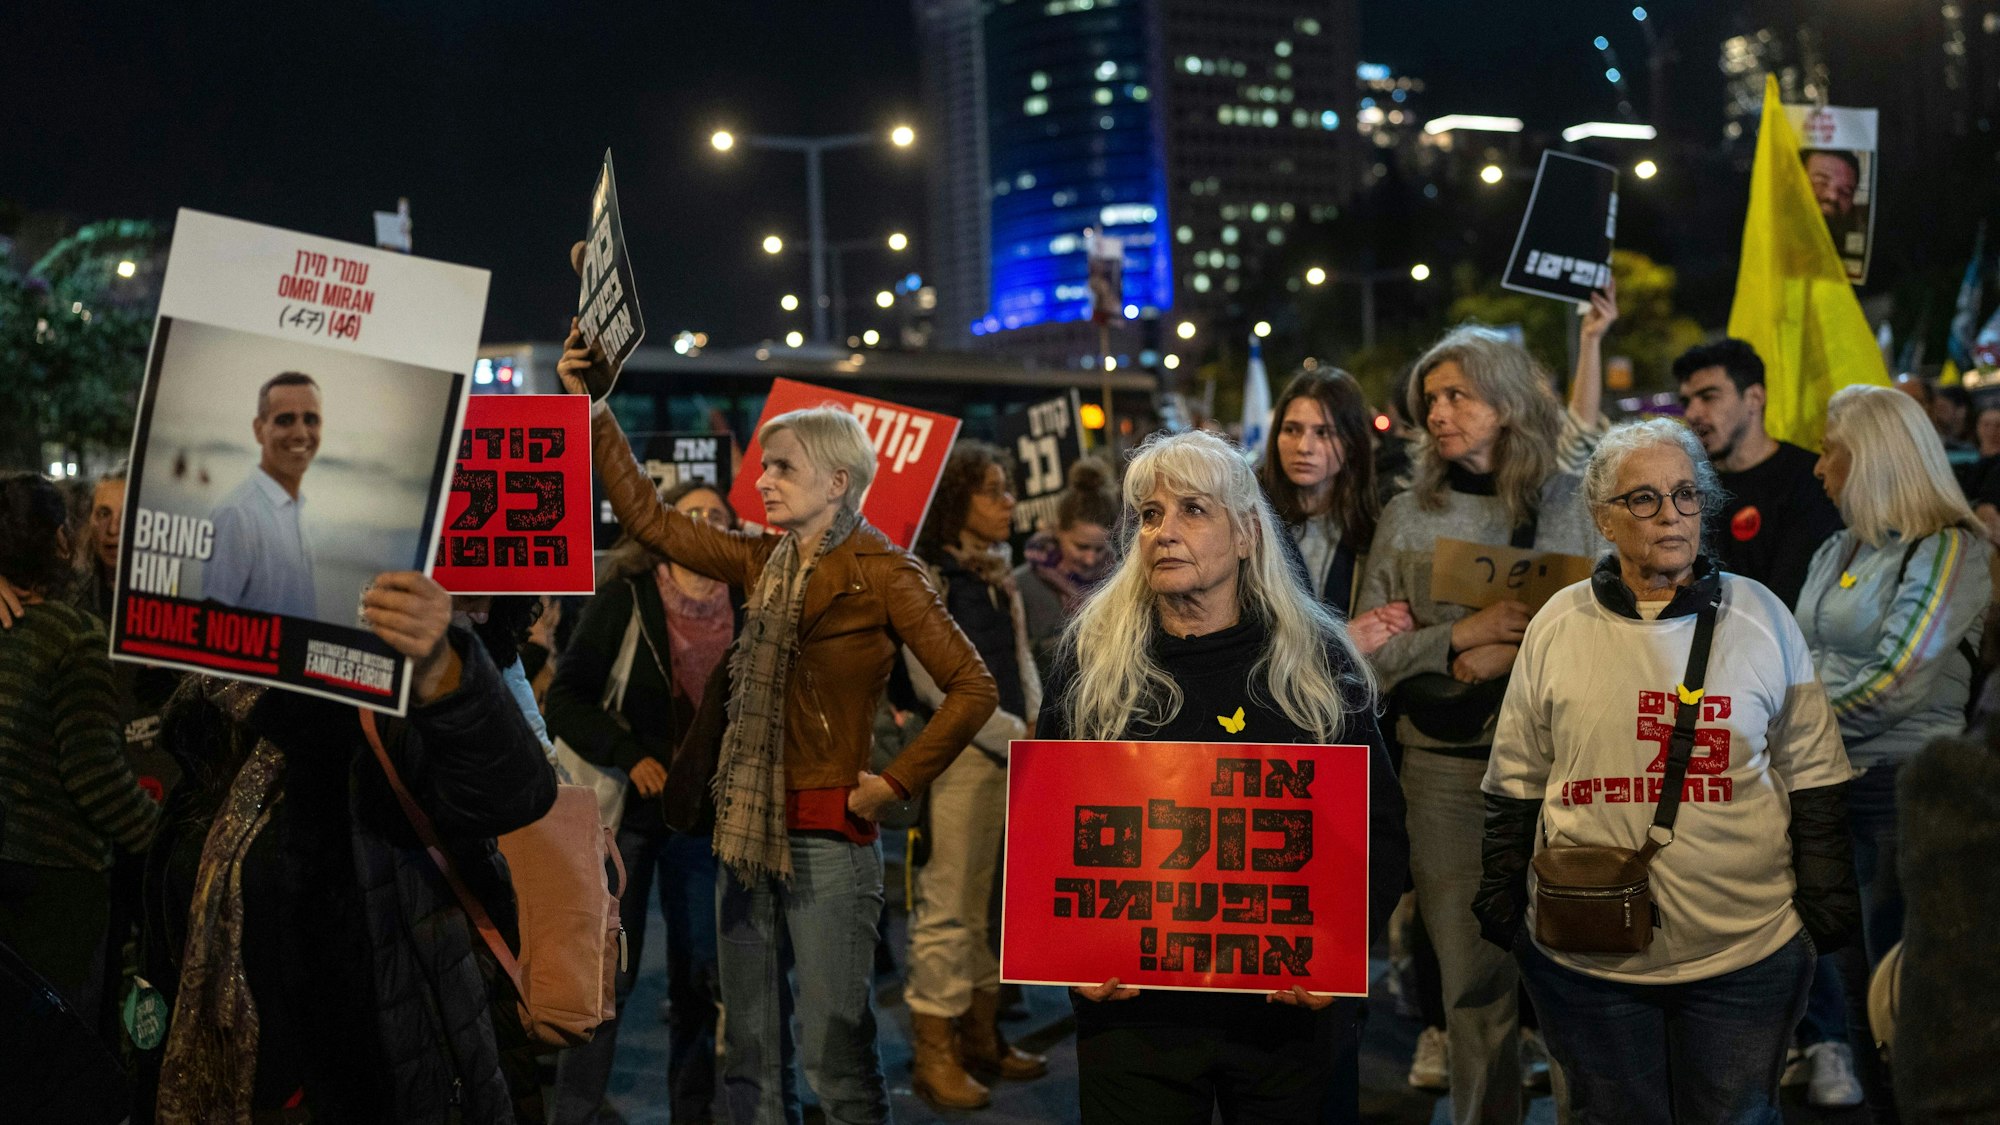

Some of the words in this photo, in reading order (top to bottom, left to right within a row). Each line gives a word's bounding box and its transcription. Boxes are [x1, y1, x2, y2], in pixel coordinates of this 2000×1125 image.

[294, 250, 328, 278] מירן
[333, 256, 369, 285] עמרי
[278, 274, 320, 303] OMRI
[322, 283, 375, 314] MIRAN
[279, 305, 325, 335] (47)
[673, 438, 717, 461] את
[449, 463, 566, 532] כל
[133, 508, 214, 560] BRING
[129, 551, 181, 597] HIM
[125, 596, 200, 645] HOME
[206, 611, 282, 660] NOW!
[305, 653, 355, 681] FAMILIES
[1211, 758, 1315, 799] את
[1074, 799, 1313, 872] כולם
[1054, 877, 1314, 925] בפעימה
[1140, 927, 1314, 977] אחת!
